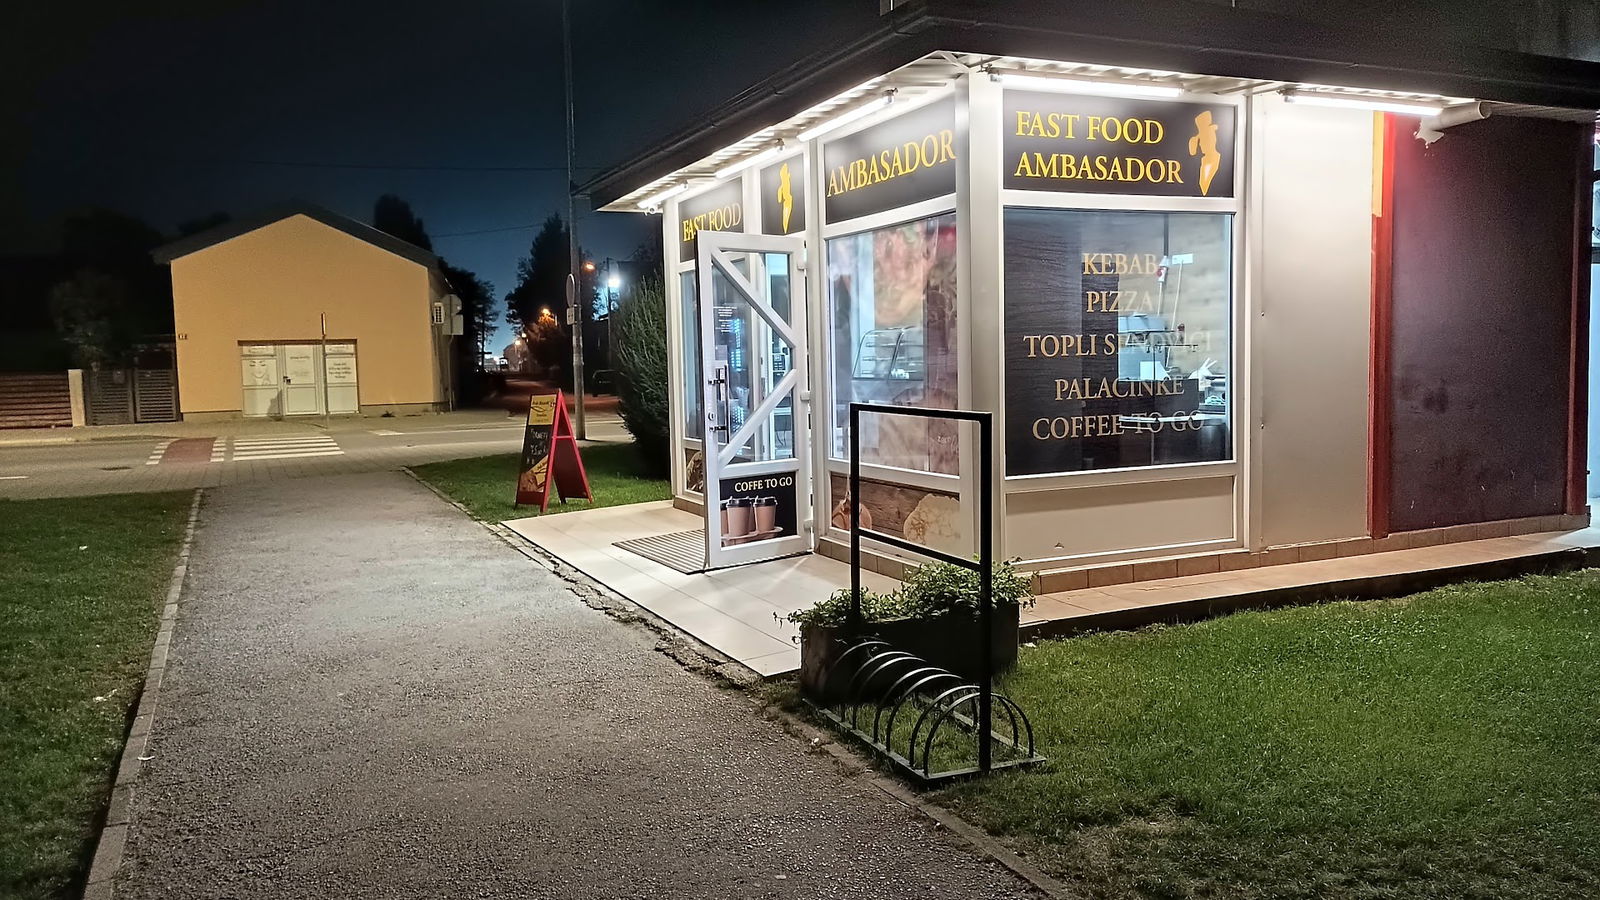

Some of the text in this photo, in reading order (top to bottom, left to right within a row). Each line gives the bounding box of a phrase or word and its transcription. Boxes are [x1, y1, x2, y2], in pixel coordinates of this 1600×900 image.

[1015, 110, 1165, 145] FAST FOOD
[825, 129, 957, 198] AMBASADOR
[1013, 151, 1185, 185] AMBASADOR
[682, 203, 742, 242] FAST FOOD
[1082, 252, 1159, 275] KEBAB
[1086, 290, 1155, 313] PIZZA
[1023, 333, 1098, 358] TOPLI
[1032, 409, 1205, 440] COFFEE TO GO
[734, 476, 793, 493] COFFE TO GO
